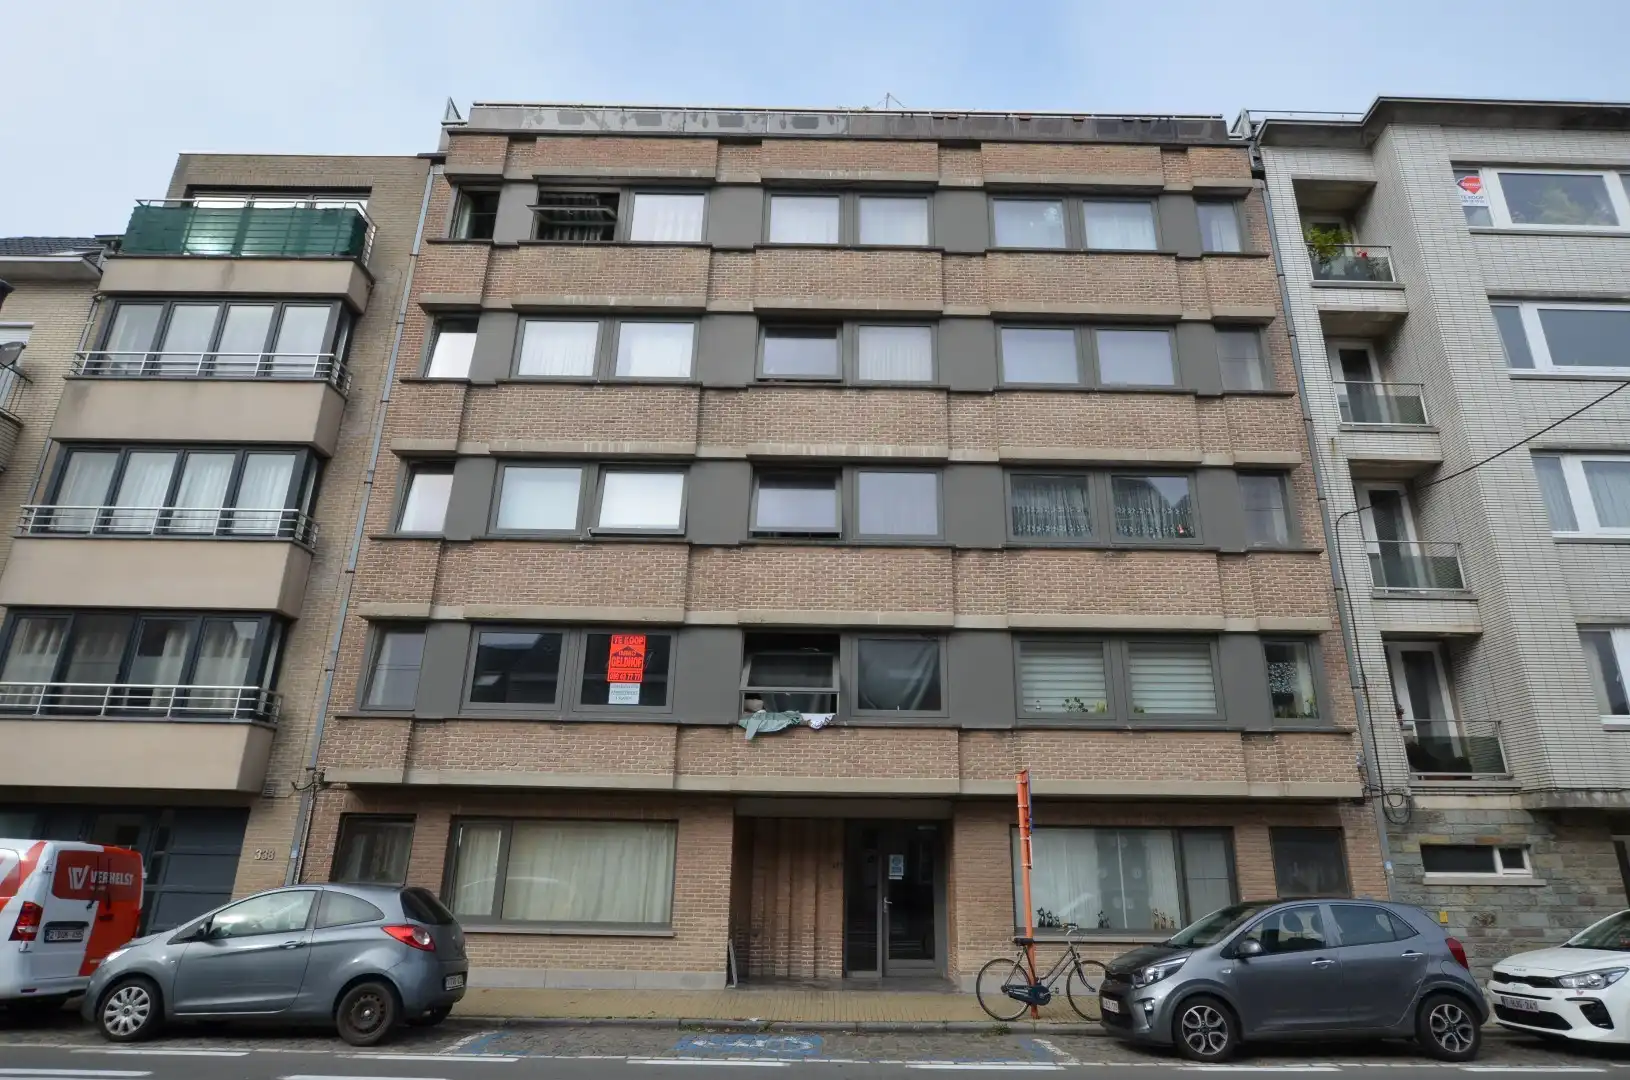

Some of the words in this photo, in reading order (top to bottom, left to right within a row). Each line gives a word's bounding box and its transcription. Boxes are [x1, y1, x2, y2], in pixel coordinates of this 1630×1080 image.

[613, 636, 623, 645] TE
[624, 636, 645, 645] KOOP
[611, 656, 643, 668] GELDHOF
[90, 870, 134, 886] VERHELST
